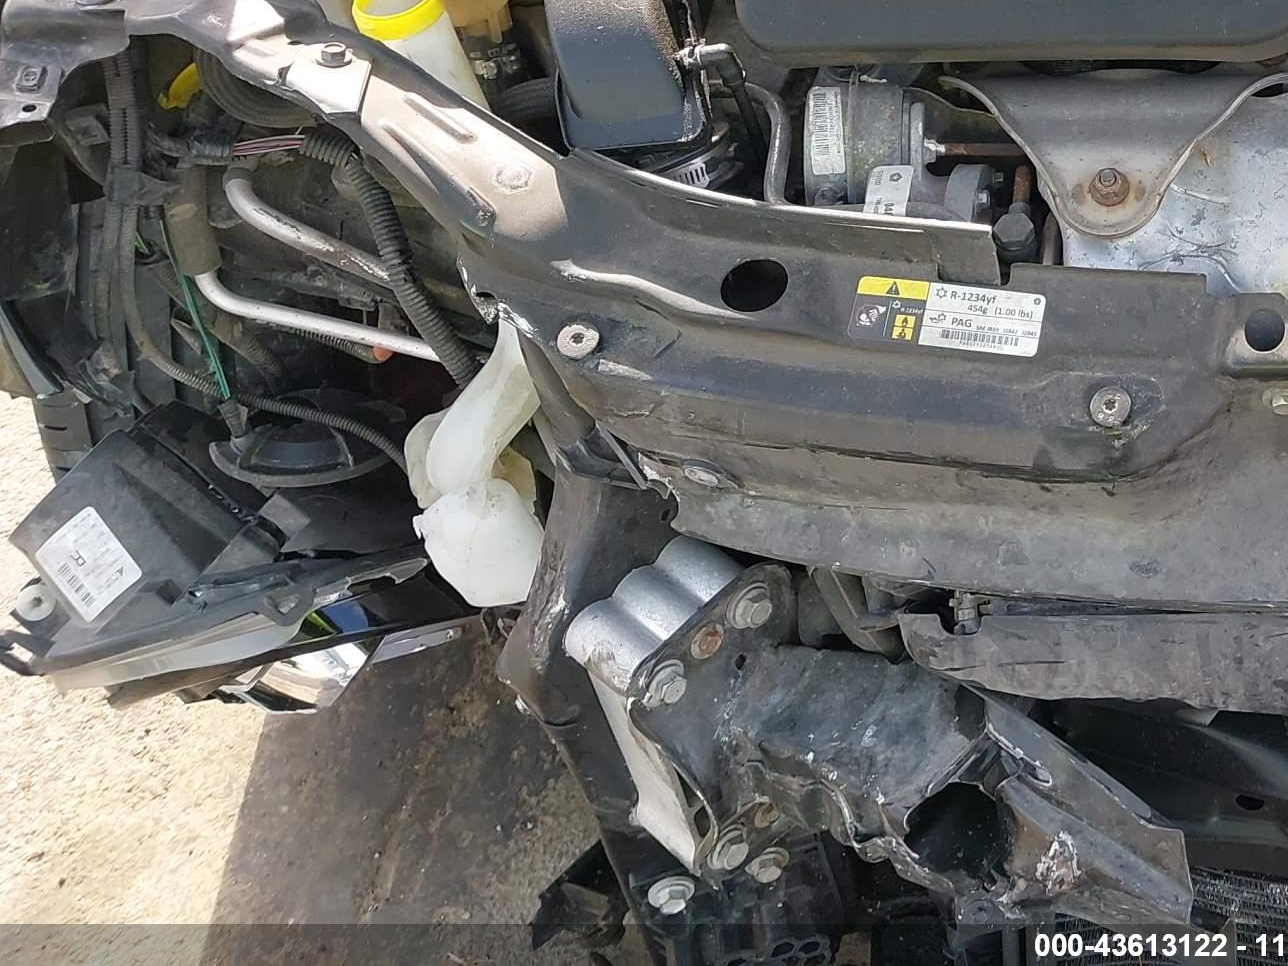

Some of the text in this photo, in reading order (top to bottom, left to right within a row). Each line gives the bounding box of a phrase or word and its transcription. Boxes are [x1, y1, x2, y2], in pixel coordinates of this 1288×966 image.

[950, 290, 997, 305] R-1234yf
[967, 304, 1034, 319] 454g (1.00 lbs)
[951, 317, 973, 328] PAG
[70, 550, 87, 567] R
